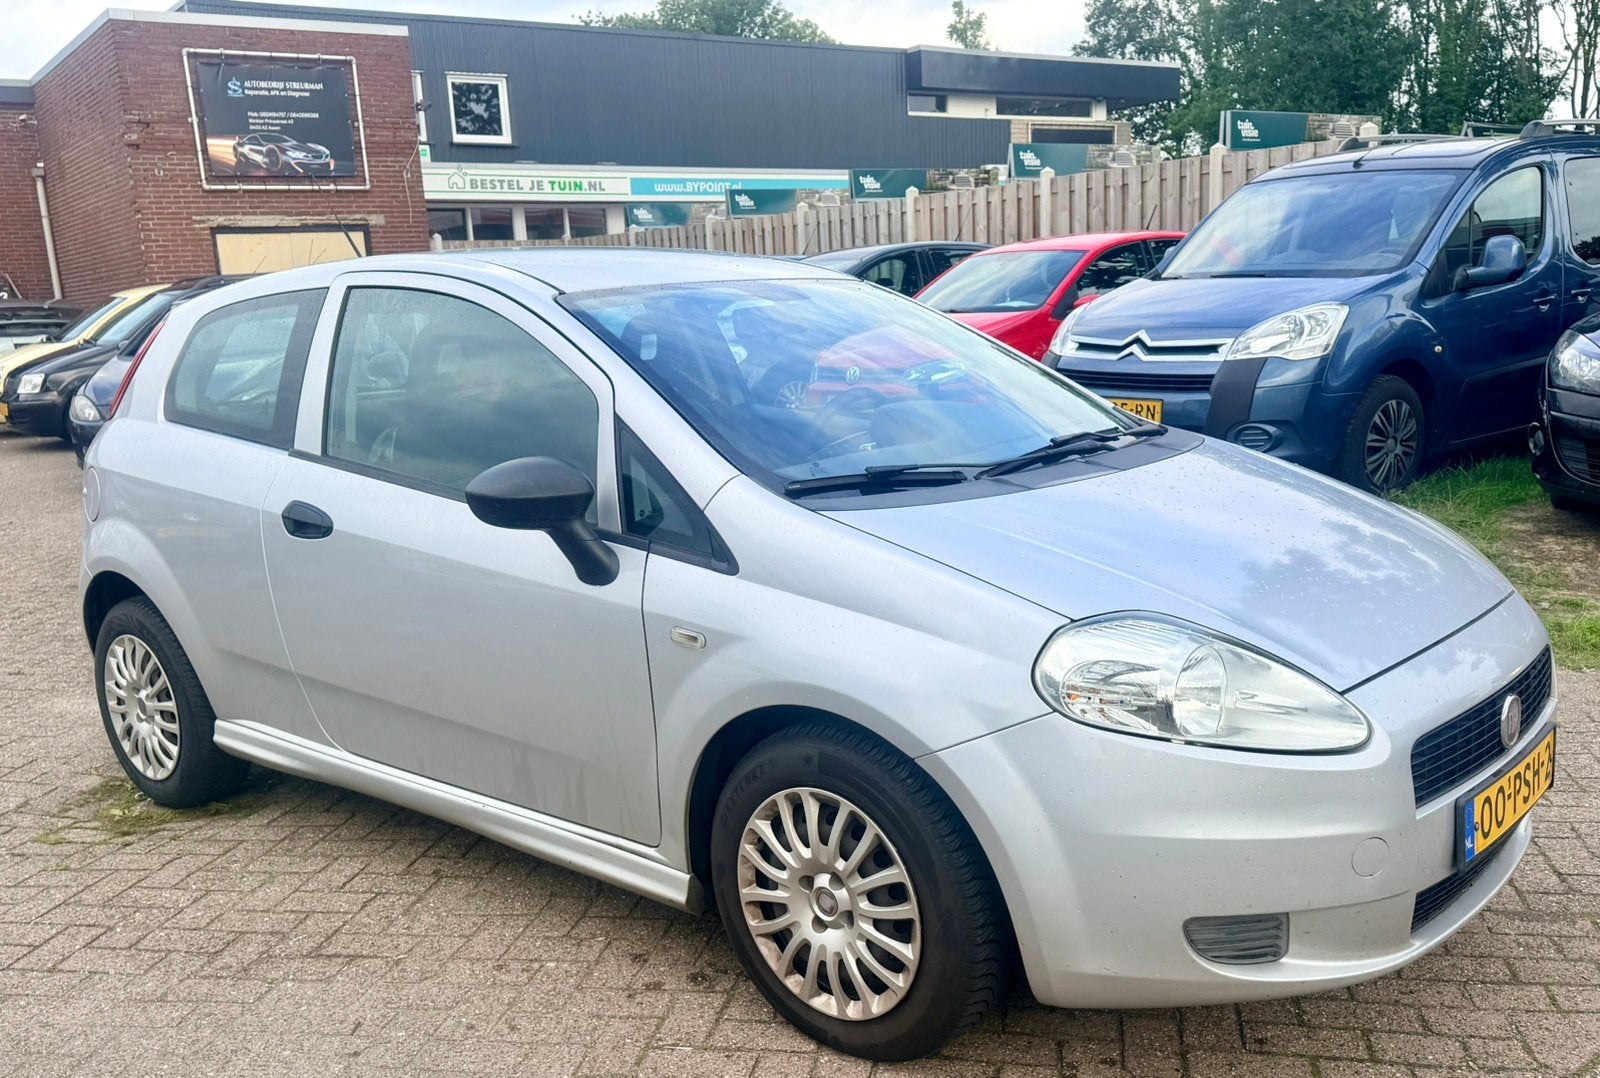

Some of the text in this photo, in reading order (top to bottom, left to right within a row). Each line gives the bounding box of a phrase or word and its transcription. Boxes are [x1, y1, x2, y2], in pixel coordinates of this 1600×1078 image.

[469, 178, 606, 192] BESTEL JE TUIN.NL
[1464, 836, 1474, 850] NL
